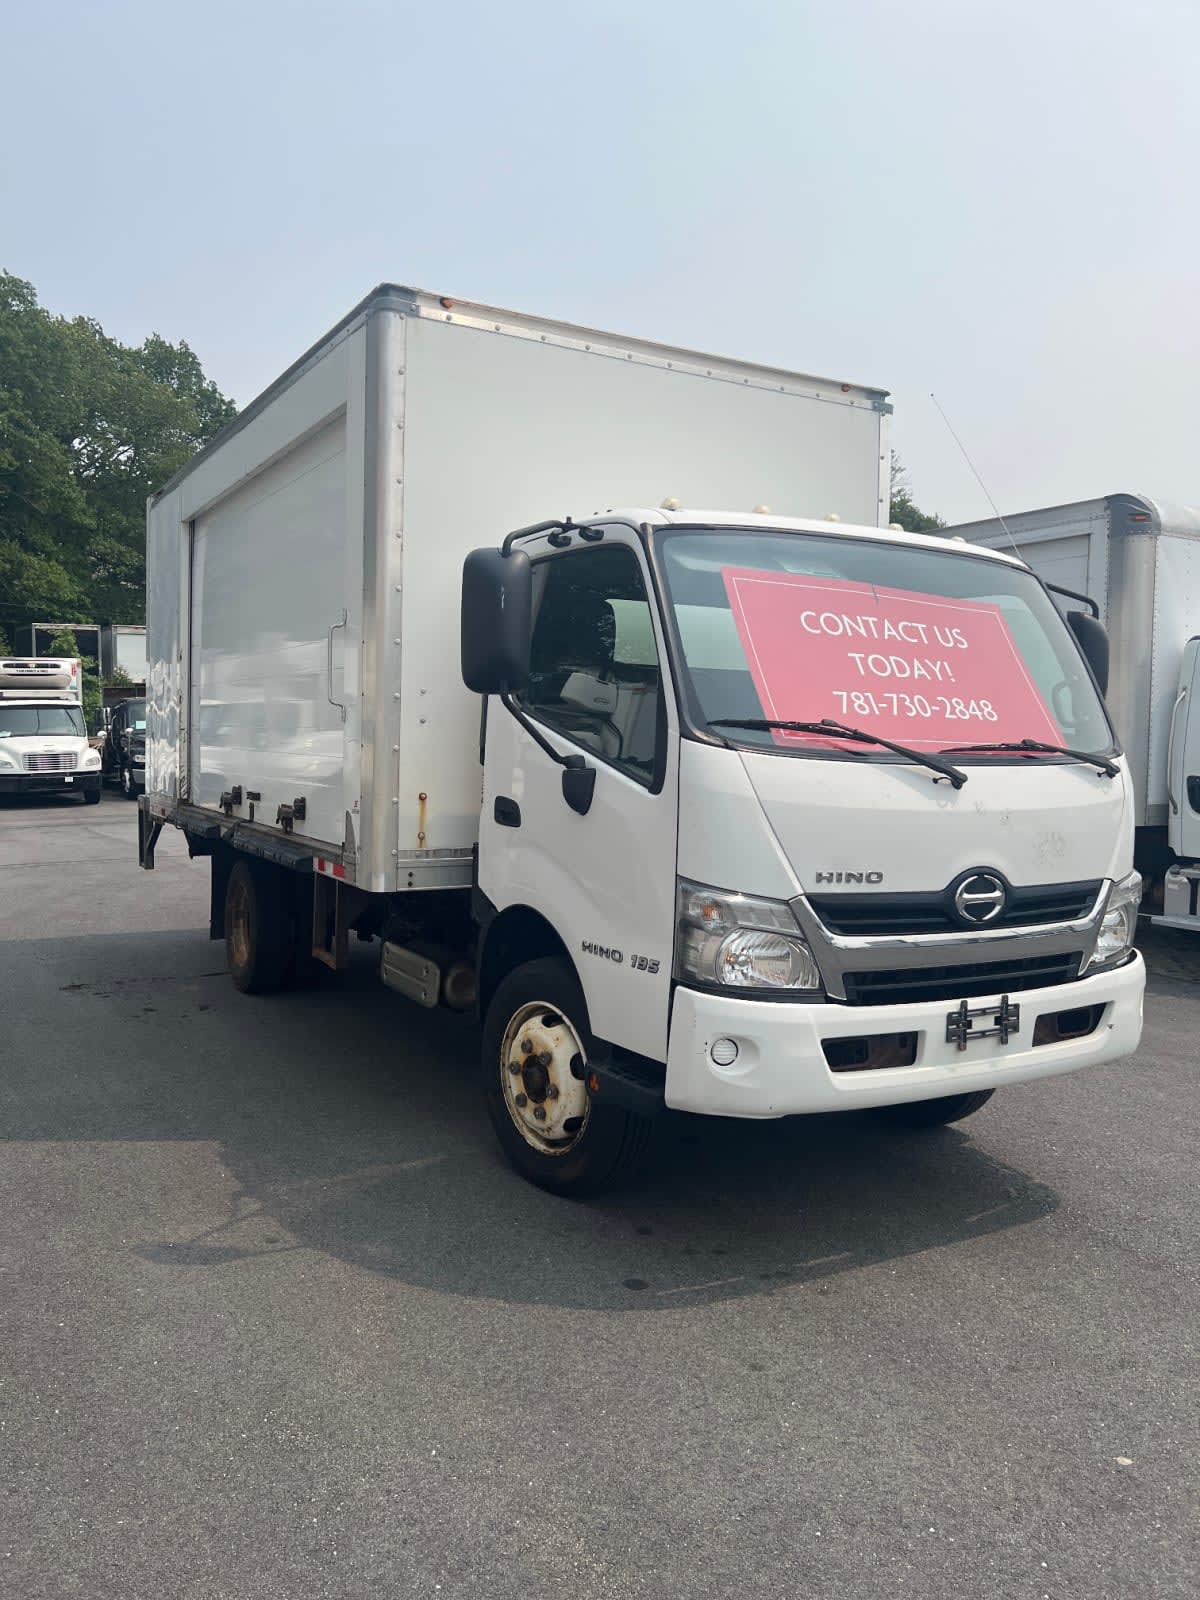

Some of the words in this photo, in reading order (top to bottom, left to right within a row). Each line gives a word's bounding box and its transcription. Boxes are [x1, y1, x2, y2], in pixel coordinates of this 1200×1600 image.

[800, 611, 929, 645] CONTACT
[935, 625, 968, 649] US
[848, 652, 956, 683] TODAY!
[832, 691, 998, 722] 781-730-2848
[816, 871, 883, 883] HINO
[582, 940, 624, 963] HINO
[631, 954, 660, 974] 195
